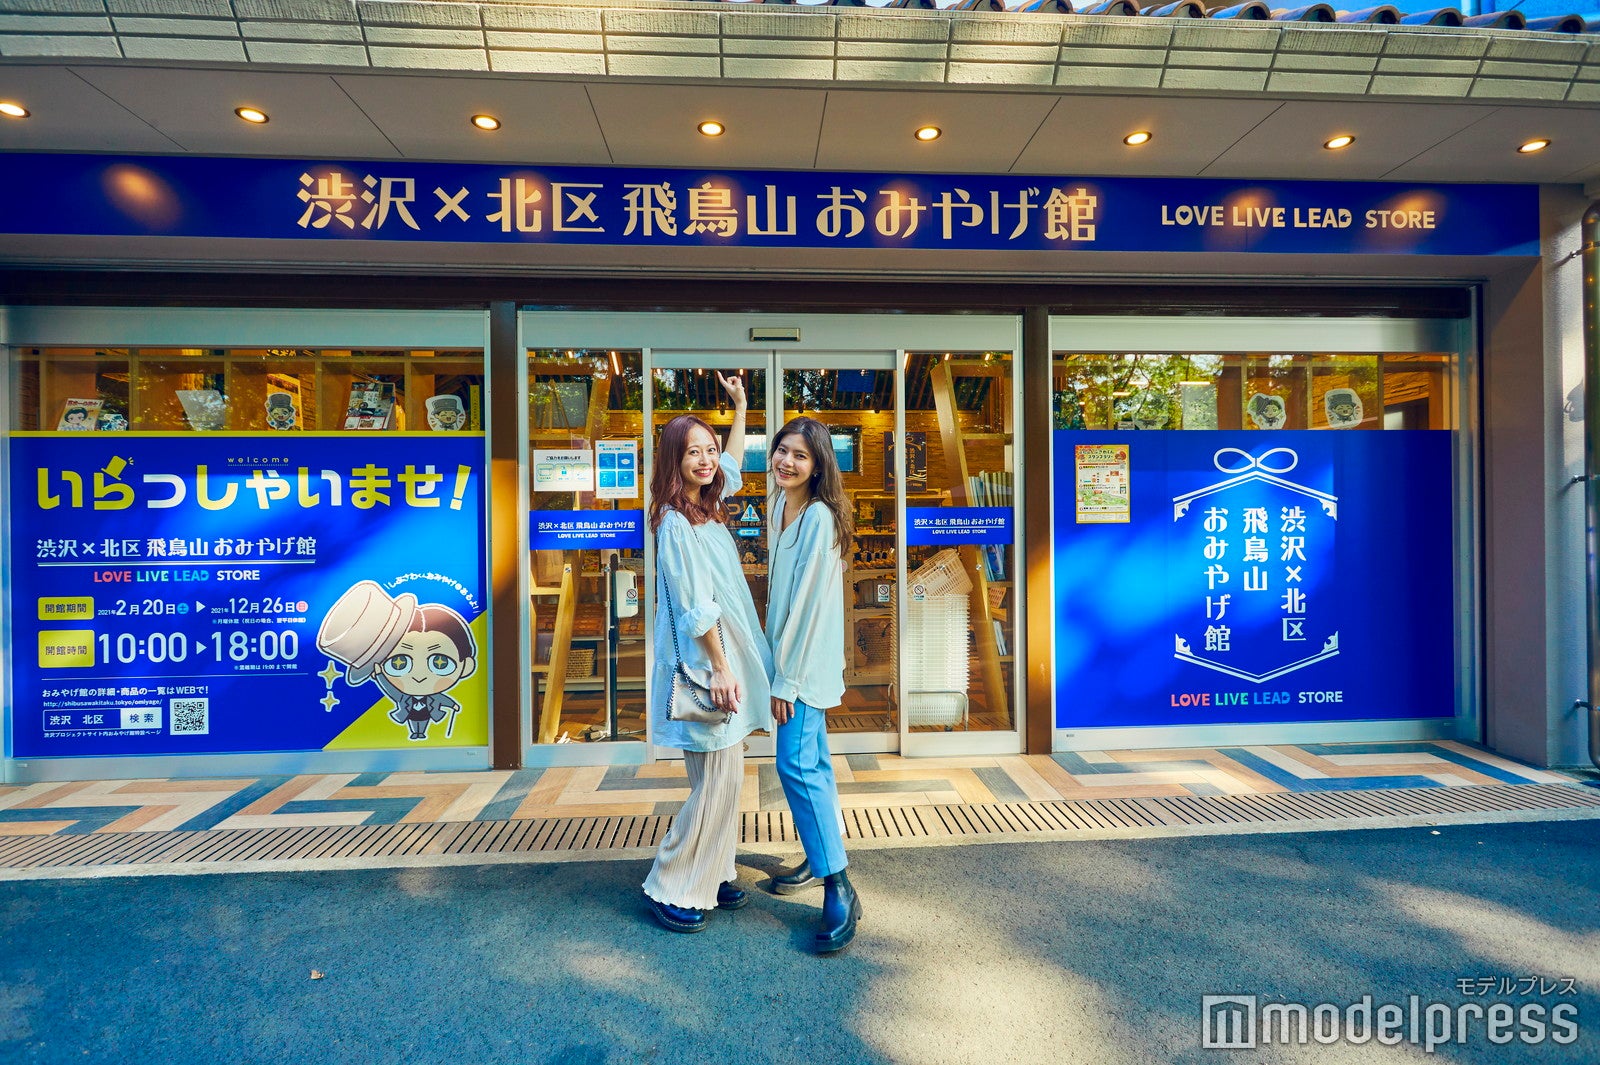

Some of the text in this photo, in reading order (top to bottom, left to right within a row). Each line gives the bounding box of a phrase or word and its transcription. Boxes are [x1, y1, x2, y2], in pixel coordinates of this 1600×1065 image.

[1161, 205, 1435, 229] LOVE LIVE LEAD STORE
[94, 569, 260, 583] LOVE LIVE LEAD STORE
[1204, 507, 1231, 651] おみやげ館
[45, 603, 86, 613] 開館期間
[45, 630, 298, 663] 開館時間 10:00 18:00
[1171, 691, 1343, 707] LOVE LIVE LEAD STORE
[49, 714, 154, 725] 渋沢 北区 検索
